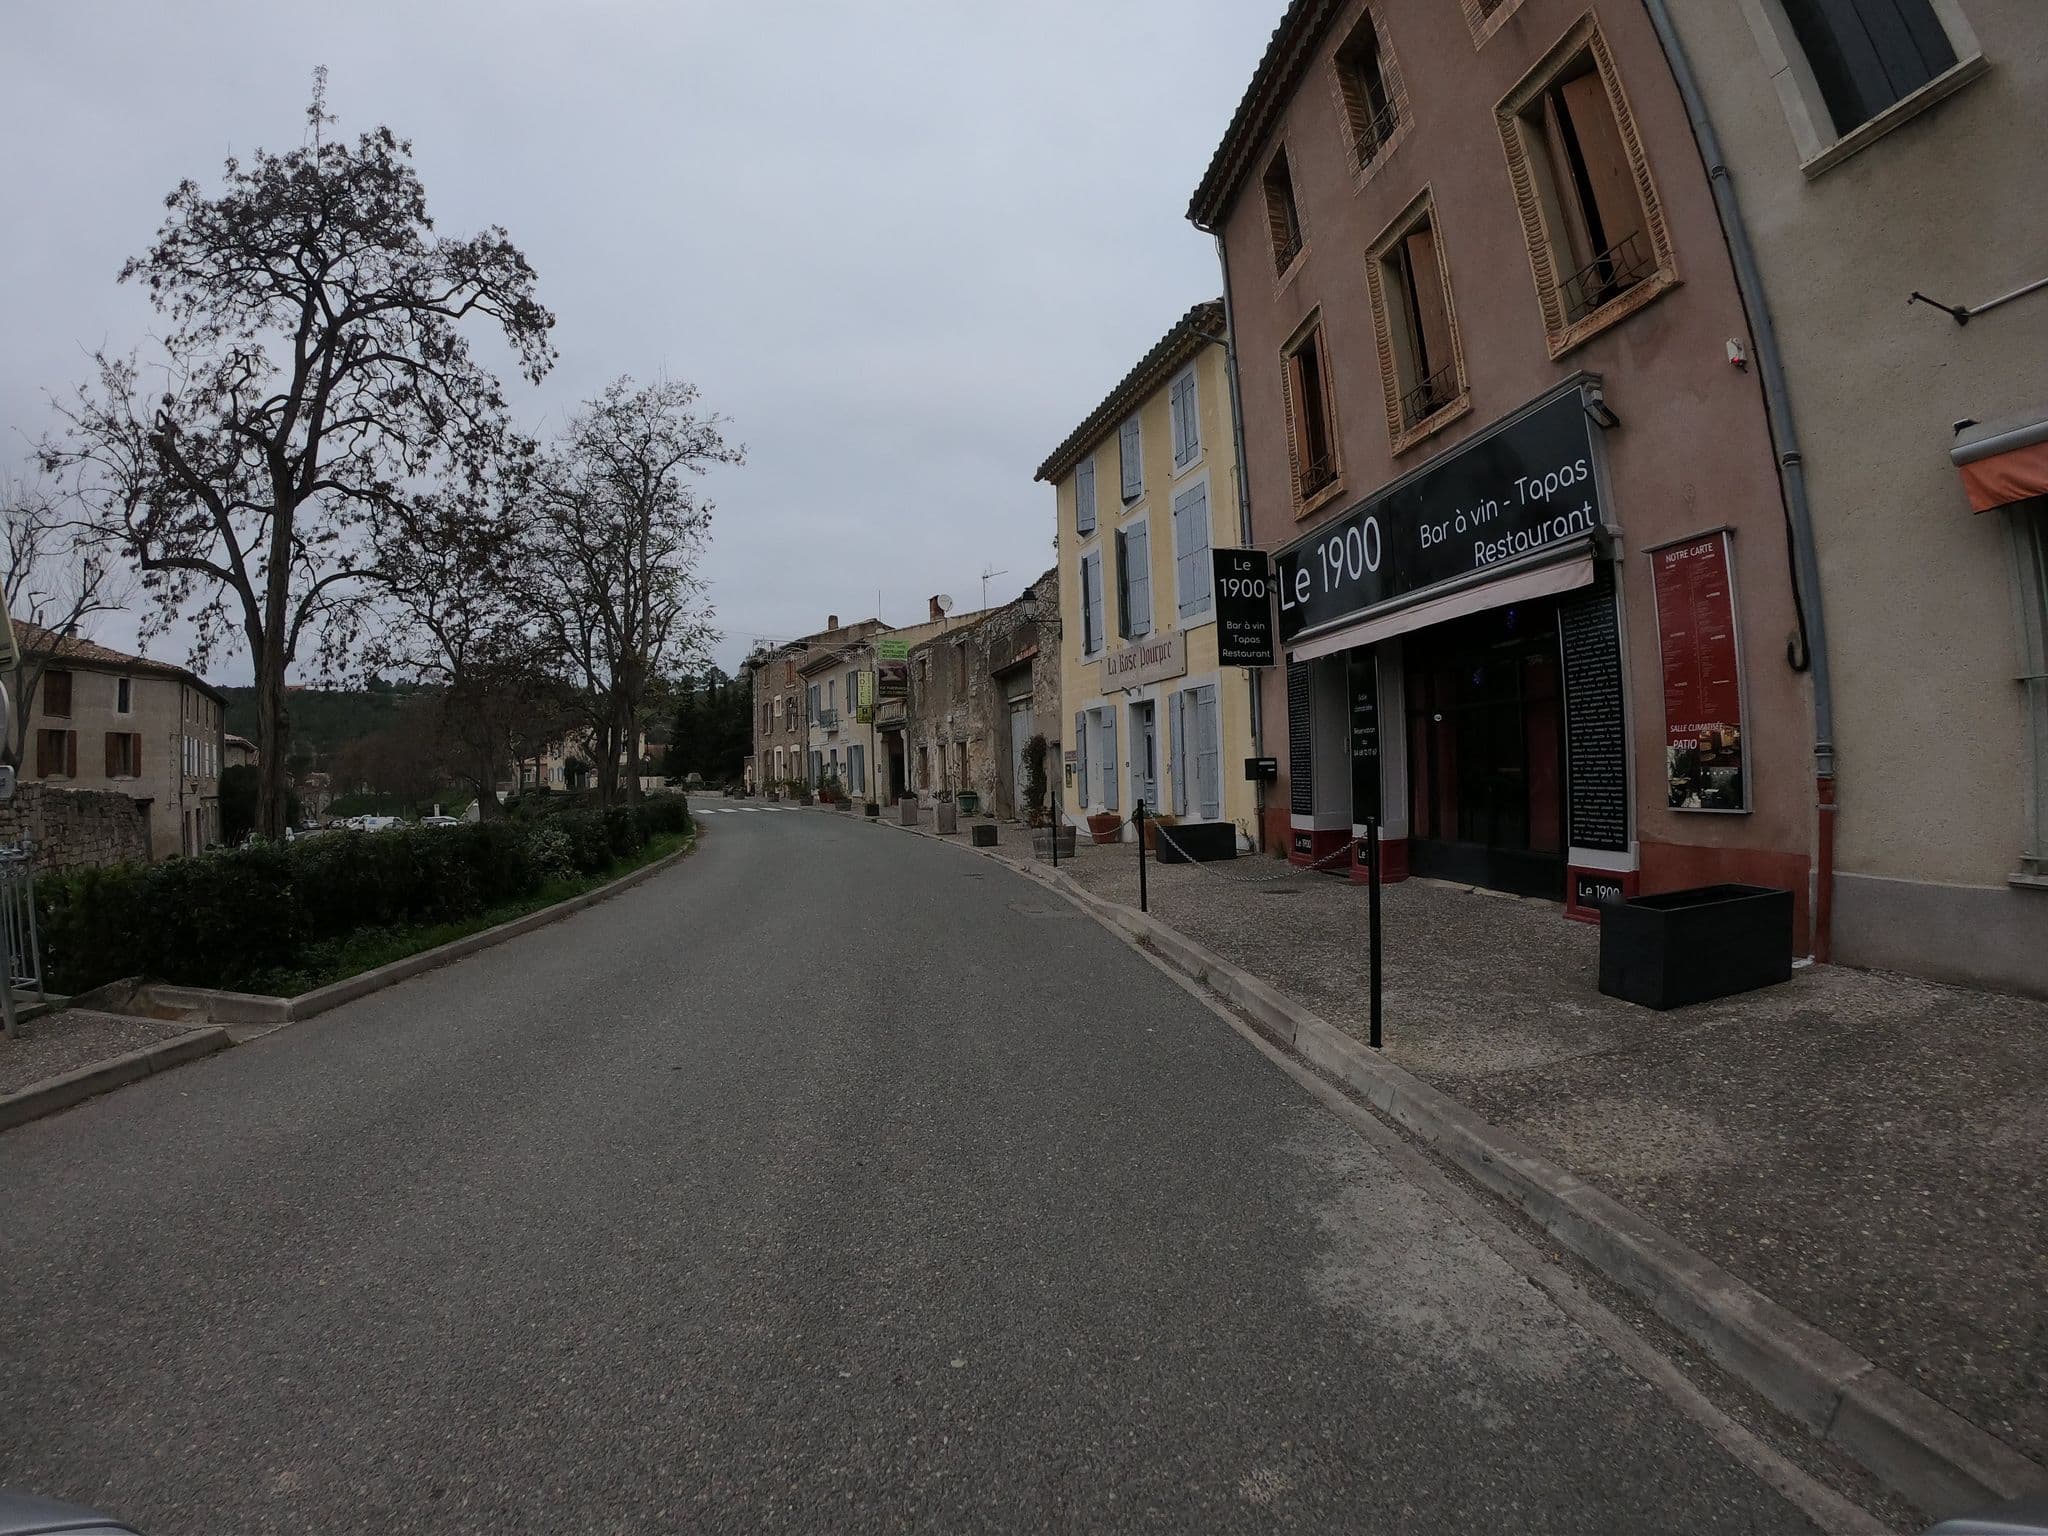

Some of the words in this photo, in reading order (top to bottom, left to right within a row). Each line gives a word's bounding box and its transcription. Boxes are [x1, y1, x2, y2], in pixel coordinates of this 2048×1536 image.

[1420, 521, 1449, 549] Bar
[1455, 509, 1466, 533] à
[1470, 499, 1498, 527] vin
[1514, 459, 1588, 505] Tapas
[1474, 501, 1595, 567] Restaurant
[1665, 549, 1689, 563] NOTRE
[1690, 543, 1713, 556] CARTE
[1234, 558, 1251, 570] Le
[1280, 566, 1311, 610] Le
[1317, 516, 1382, 593] 1900
[1220, 578, 1265, 598] 1900
[1227, 621, 1241, 629] Bar
[1245, 621, 1250, 629] à
[1252, 622, 1265, 630] vin
[1233, 635, 1260, 645] Tapas
[1222, 649, 1270, 658] Restaurant
[1107, 658, 1117, 675] La
[1119, 653, 1137, 673] Rose
[1670, 724, 1688, 733] SALLE
[1673, 739, 1697, 750] PATIO
[1295, 838, 1302, 847] Le
[1358, 849, 1366, 859] Le
[1579, 881, 1593, 897] Le
